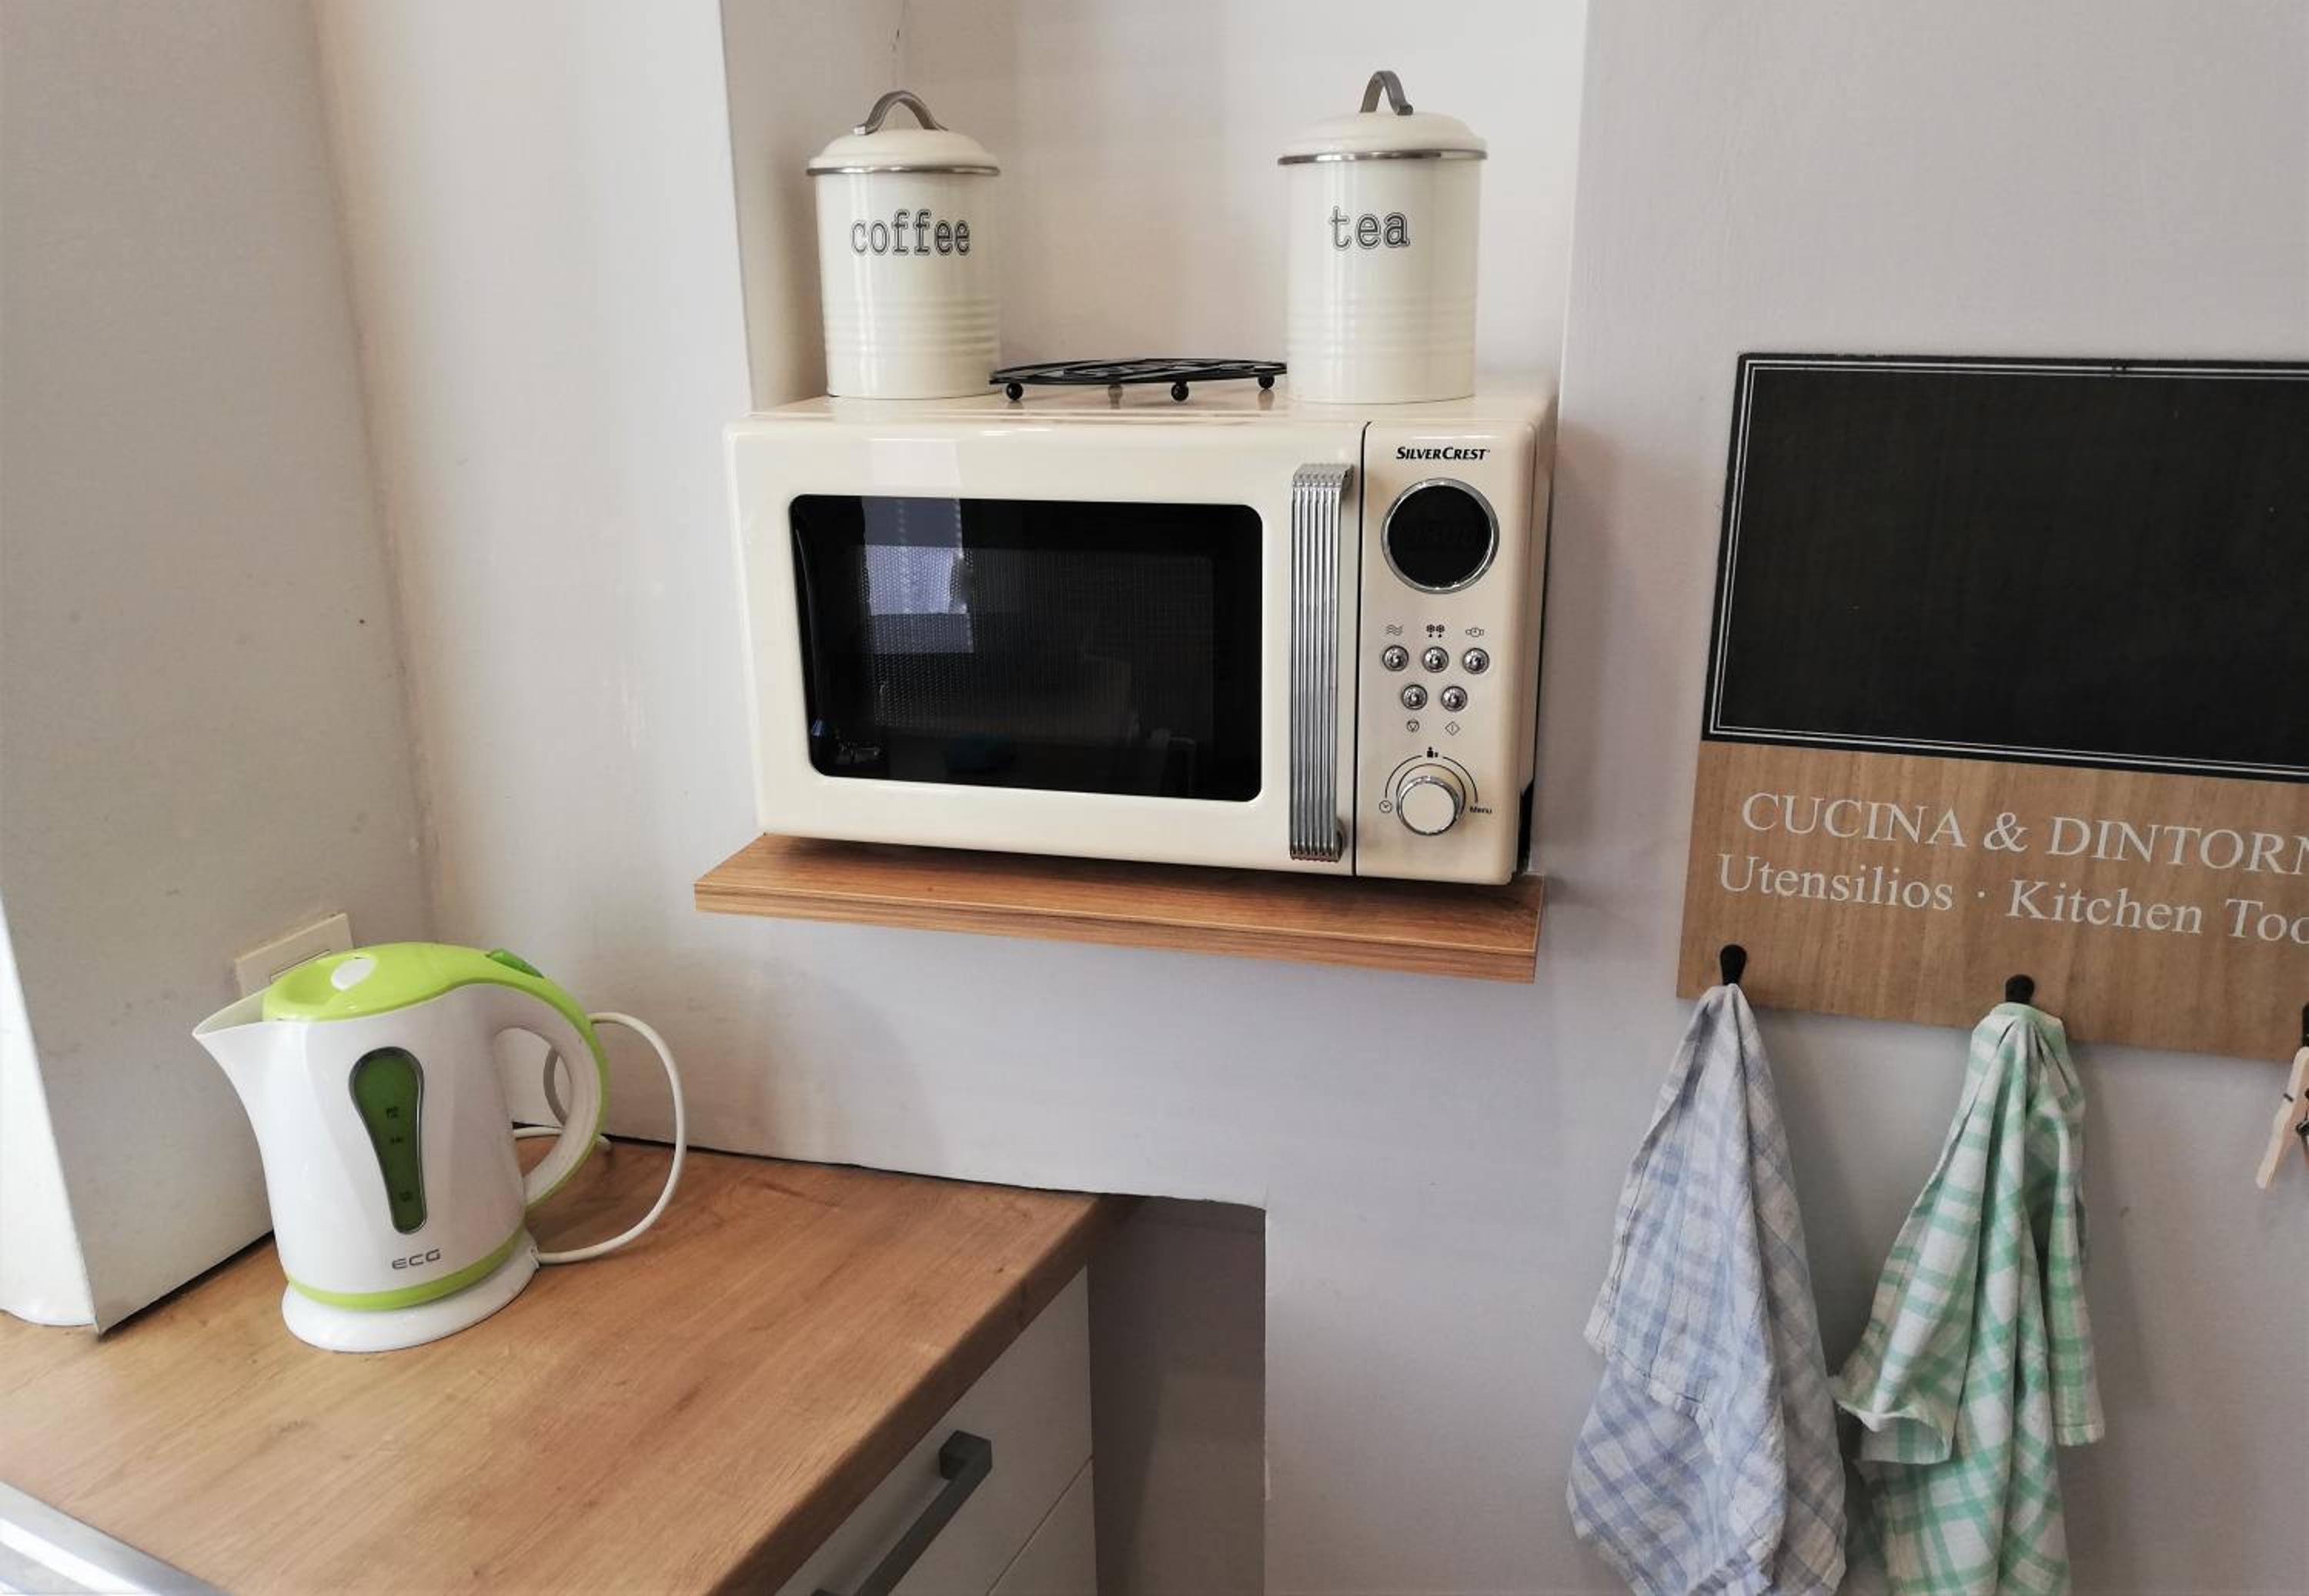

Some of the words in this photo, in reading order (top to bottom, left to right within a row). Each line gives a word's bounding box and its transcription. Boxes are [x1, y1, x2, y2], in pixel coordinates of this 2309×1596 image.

[850, 209, 971, 257] coffee
[1329, 205, 1410, 250] tea
[1469, 806, 1492, 814] Menu
[1742, 792, 1967, 848] CUCINA
[1983, 812, 2028, 853] &
[1718, 853, 1954, 912] Utensilios
[2006, 879, 2203, 934] Kitchen
[392, 1248, 441, 1270] ECG
